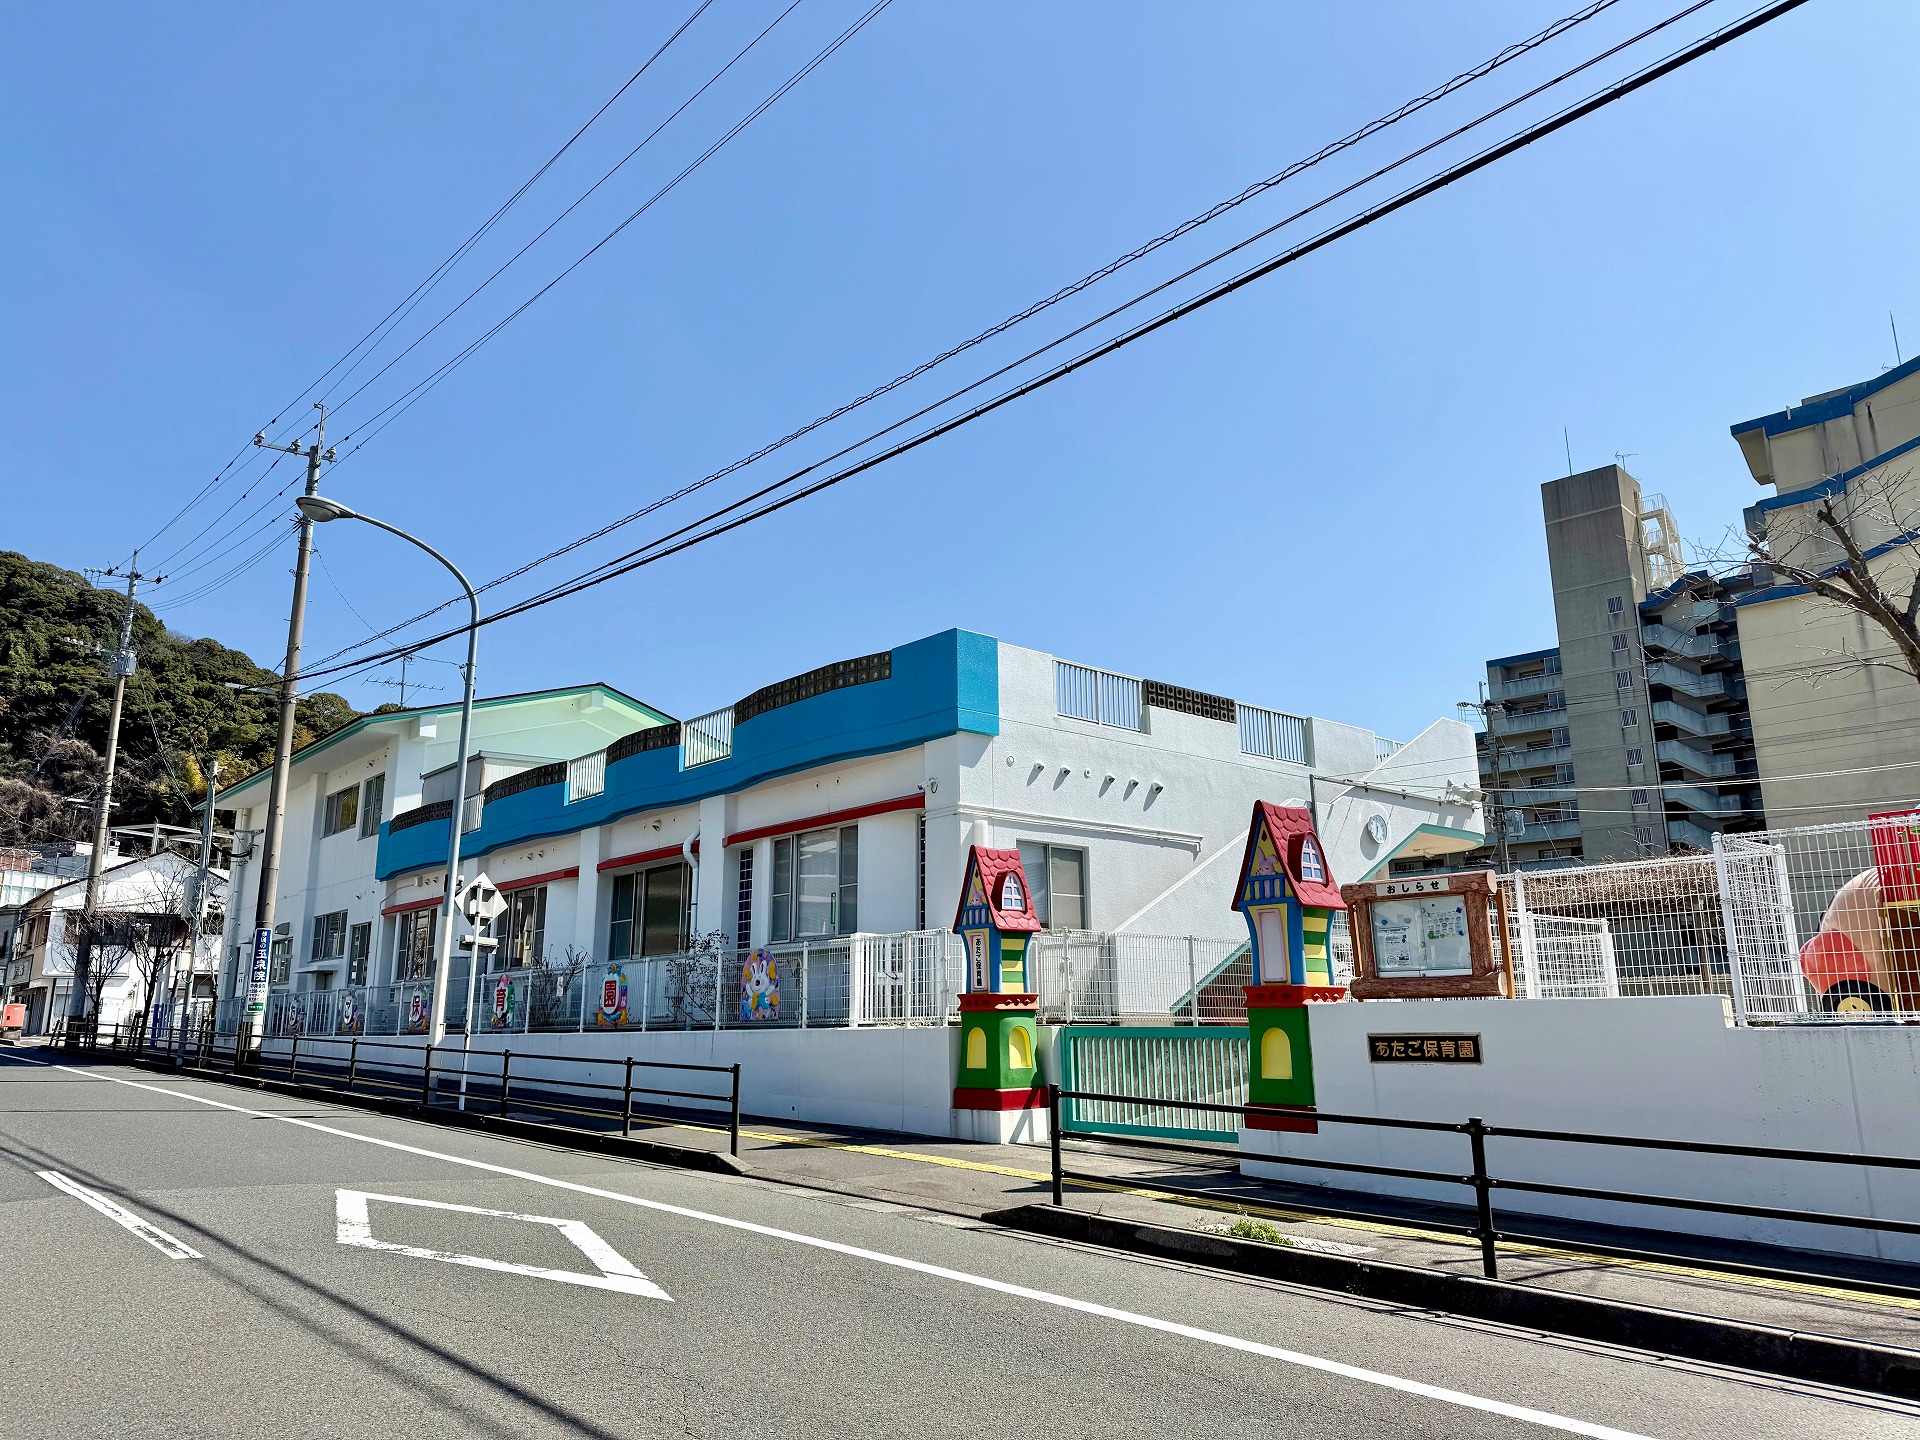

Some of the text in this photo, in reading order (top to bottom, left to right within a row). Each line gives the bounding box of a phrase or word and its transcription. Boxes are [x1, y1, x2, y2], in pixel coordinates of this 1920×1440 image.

[1386, 880, 1440, 894] おしらせ
[496, 987, 507, 1012] 育
[603, 979, 617, 1008] 園
[411, 995, 421, 1016] 保
[1375, 1039, 1475, 1058] あたご保育園
